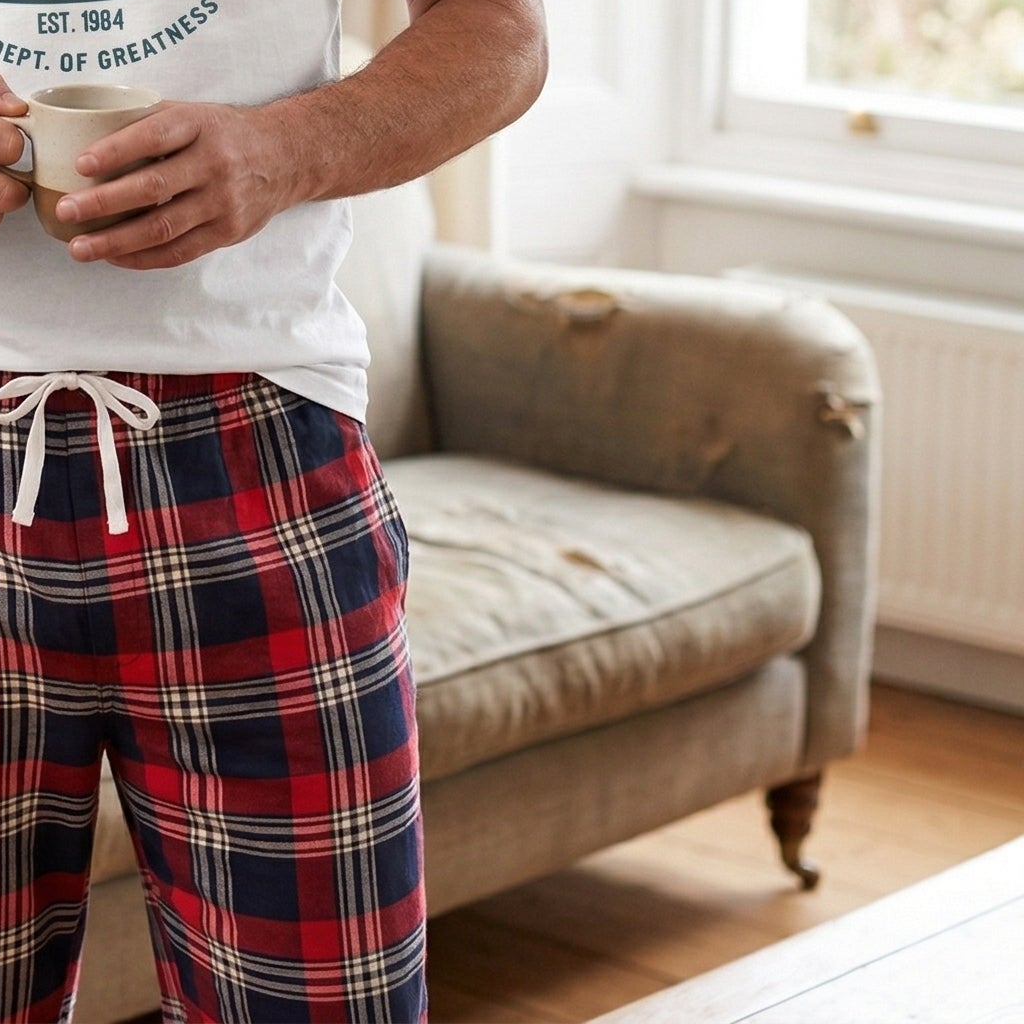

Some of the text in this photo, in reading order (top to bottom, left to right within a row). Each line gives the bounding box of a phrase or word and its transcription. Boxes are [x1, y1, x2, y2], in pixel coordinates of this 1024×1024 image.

[37, 8, 125, 34] EST. 1984
[60, 52, 87, 72] OF
